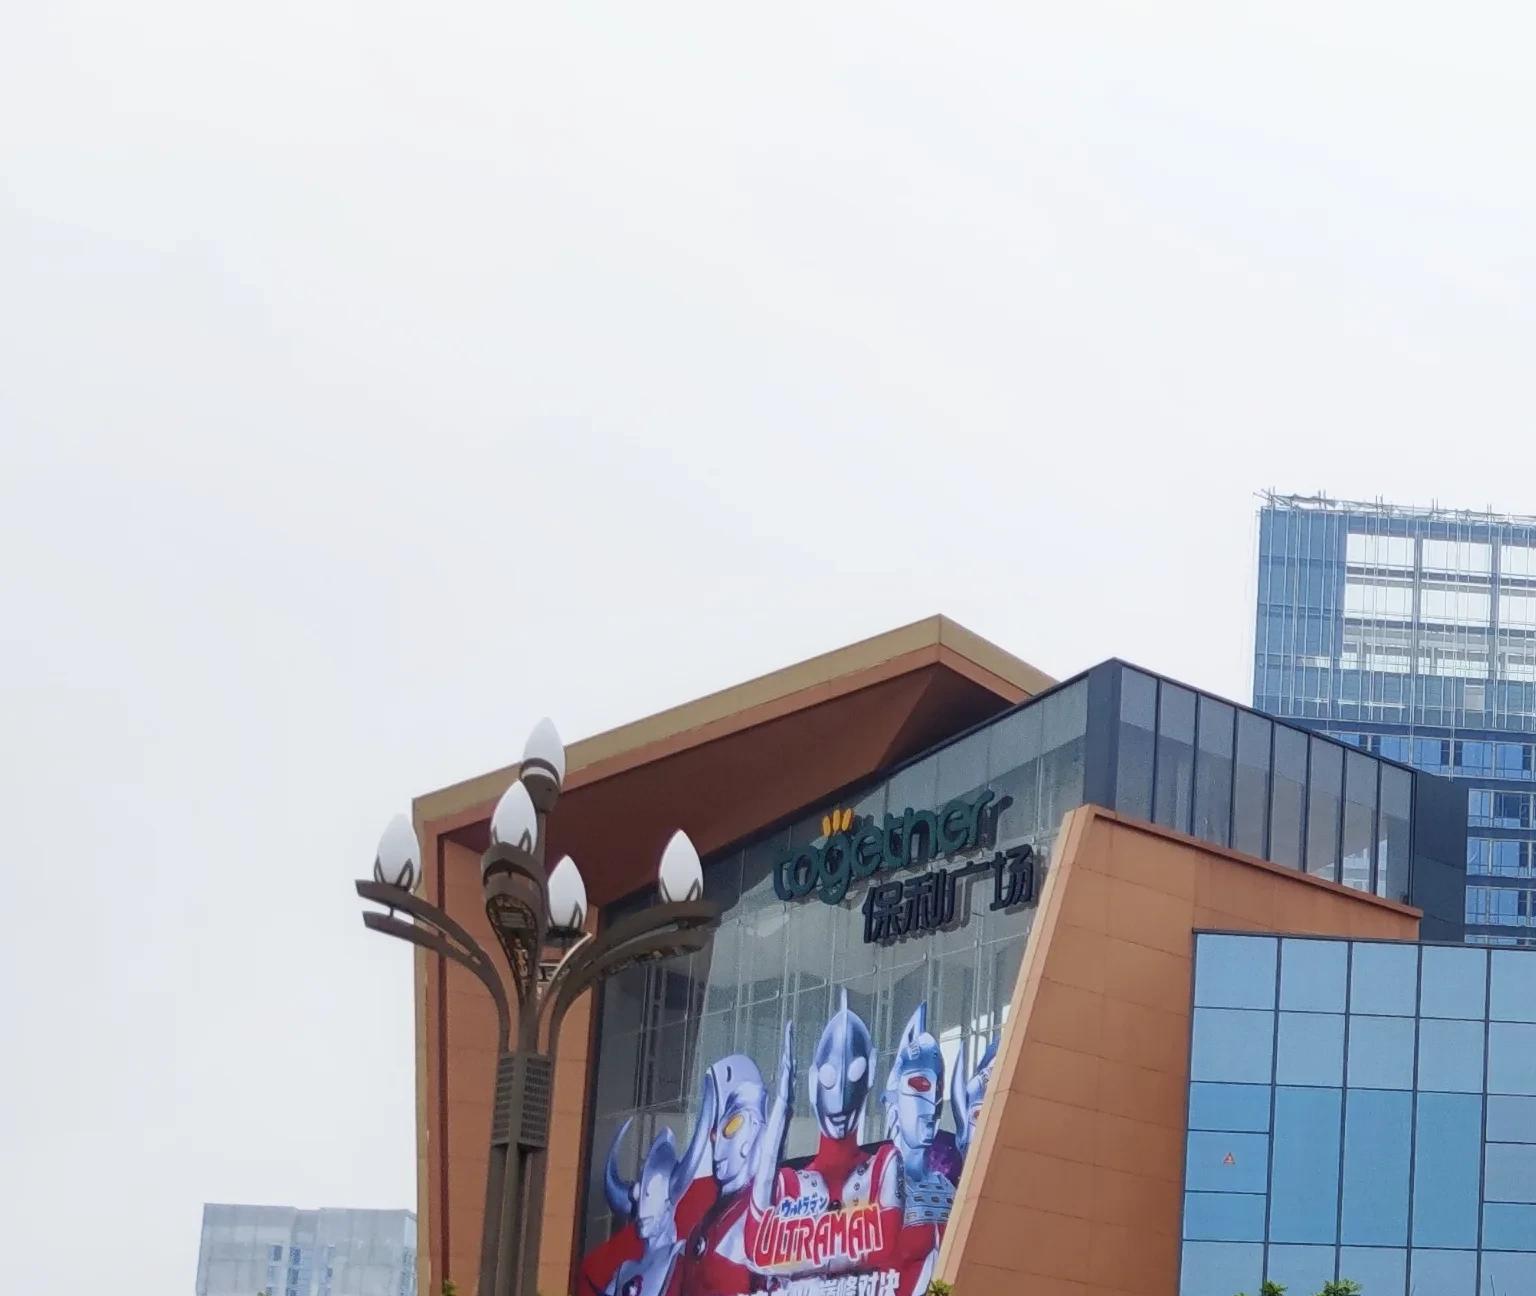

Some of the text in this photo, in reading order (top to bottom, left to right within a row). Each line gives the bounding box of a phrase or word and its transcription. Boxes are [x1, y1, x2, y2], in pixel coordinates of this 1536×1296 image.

[773, 789, 995, 904] together
[862, 844, 1034, 943] 保利广场
[753, 1203, 884, 1269] ULTRAMAN
